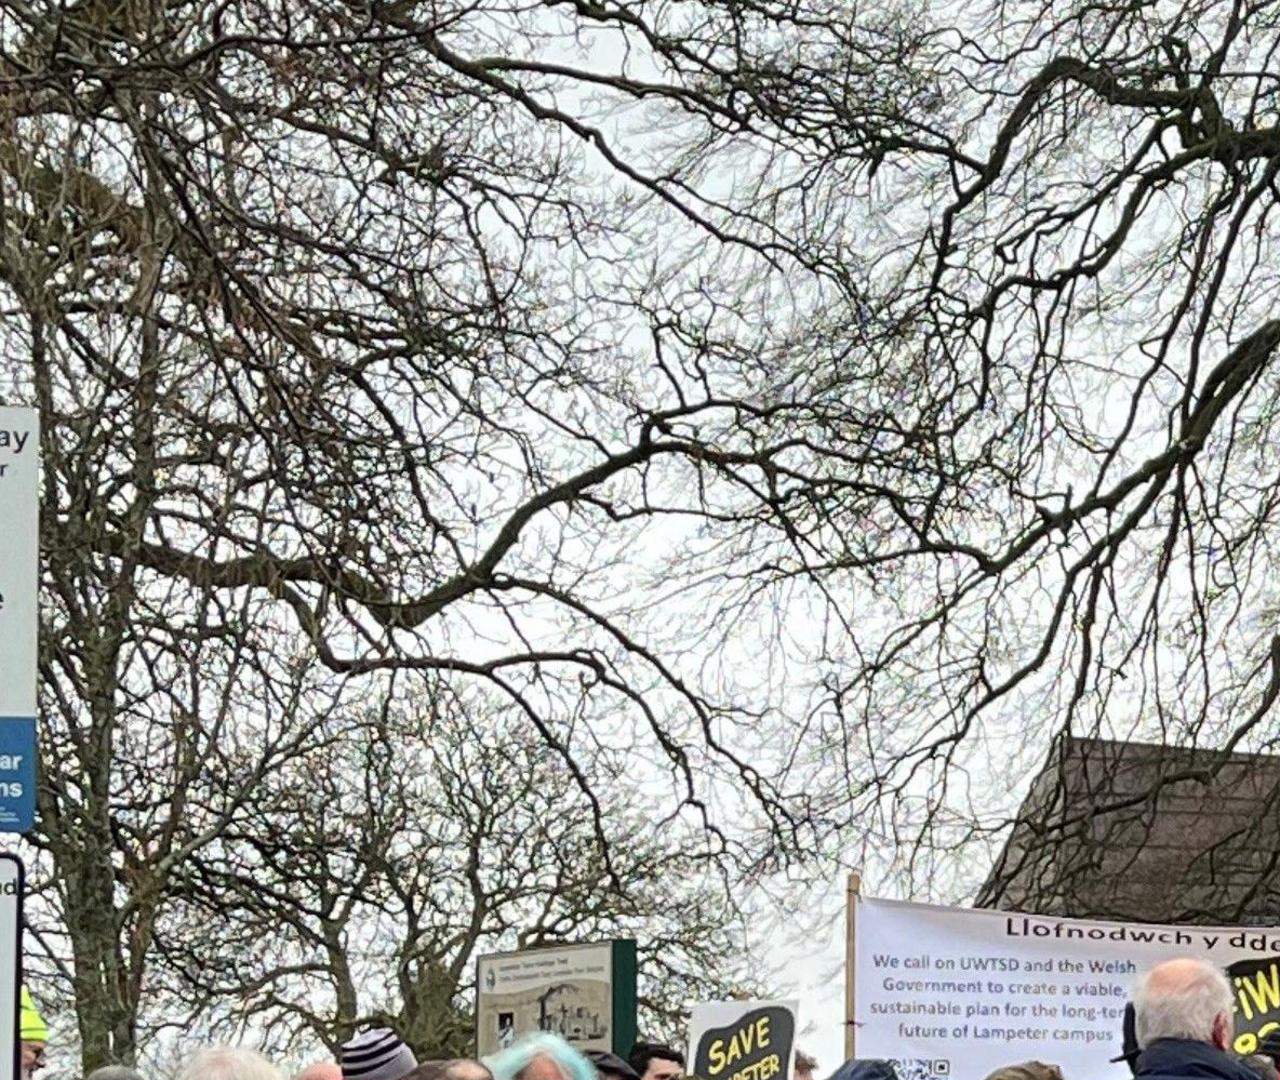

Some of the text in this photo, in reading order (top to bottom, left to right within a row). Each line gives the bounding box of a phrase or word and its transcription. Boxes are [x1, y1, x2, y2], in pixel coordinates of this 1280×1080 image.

[1006, 917, 1192, 946] Llofnodwch
[1202, 933, 1219, 949] y
[872, 954, 1137, 974] We call on UWTSD and the Welsh
[882, 977, 984, 994] Government
[988, 980, 1004, 994] to
[1008, 981, 1057, 996] create
[1062, 984, 1070, 996] a
[869, 999, 1125, 1022] sustainable plan for the long-ter
[898, 1022, 1114, 1043] future of Lampeter campus
[707, 1015, 771, 1075] SAVE
